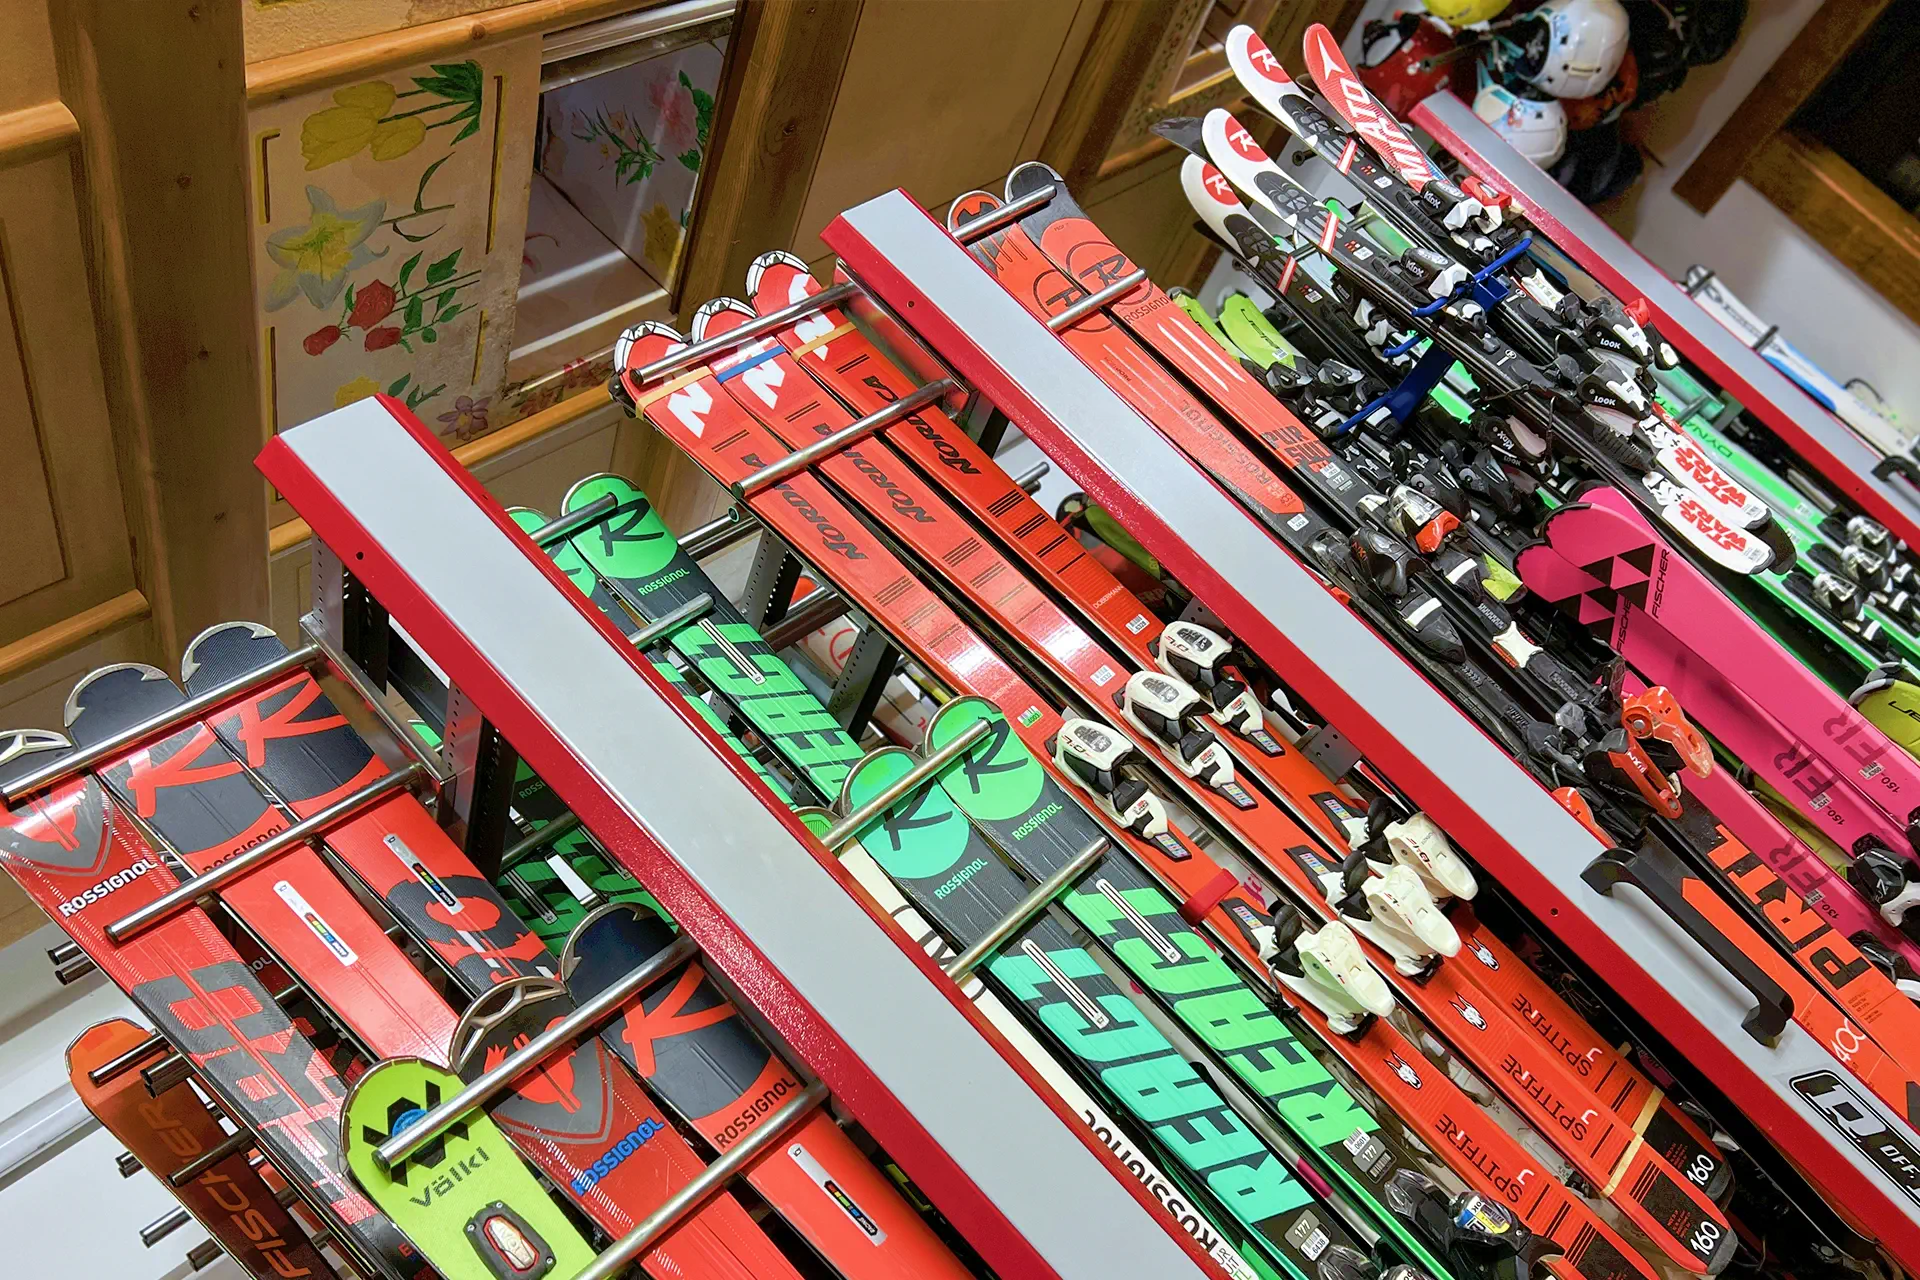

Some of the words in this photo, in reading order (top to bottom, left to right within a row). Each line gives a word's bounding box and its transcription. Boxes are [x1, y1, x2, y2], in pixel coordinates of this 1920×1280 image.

[1600, 338, 1621, 350] LOOK
[862, 375, 982, 475] NORDCA
[1594, 394, 1616, 407] LOOK
[813, 422, 937, 523] NORDIA
[740, 452, 868, 560] NORDIA
[637, 567, 690, 597] ROSSIGNOL
[1652, 548, 1671, 620] FISCHER
[1617, 596, 1633, 654] FISCHE
[1012, 802, 1063, 841] ROSSIGNOL
[58, 858, 157, 918] ROSSIGNOL
[934, 857, 988, 900] ROSSIGNOL
[1510, 993, 1594, 1078] SPITFIRE
[714, 1077, 797, 1149] ROSSIGNOL
[1500, 1053, 1589, 1142] SPITFIRE
[571, 1117, 665, 1197] ROSSIGNOL
[1361, 1144, 1379, 1164] 177
[1435, 1112, 1524, 1204] SPITFIRE
[1687, 1154, 1715, 1186] 160
[1294, 1218, 1312, 1239] 177
[1690, 1221, 1720, 1256] 160
